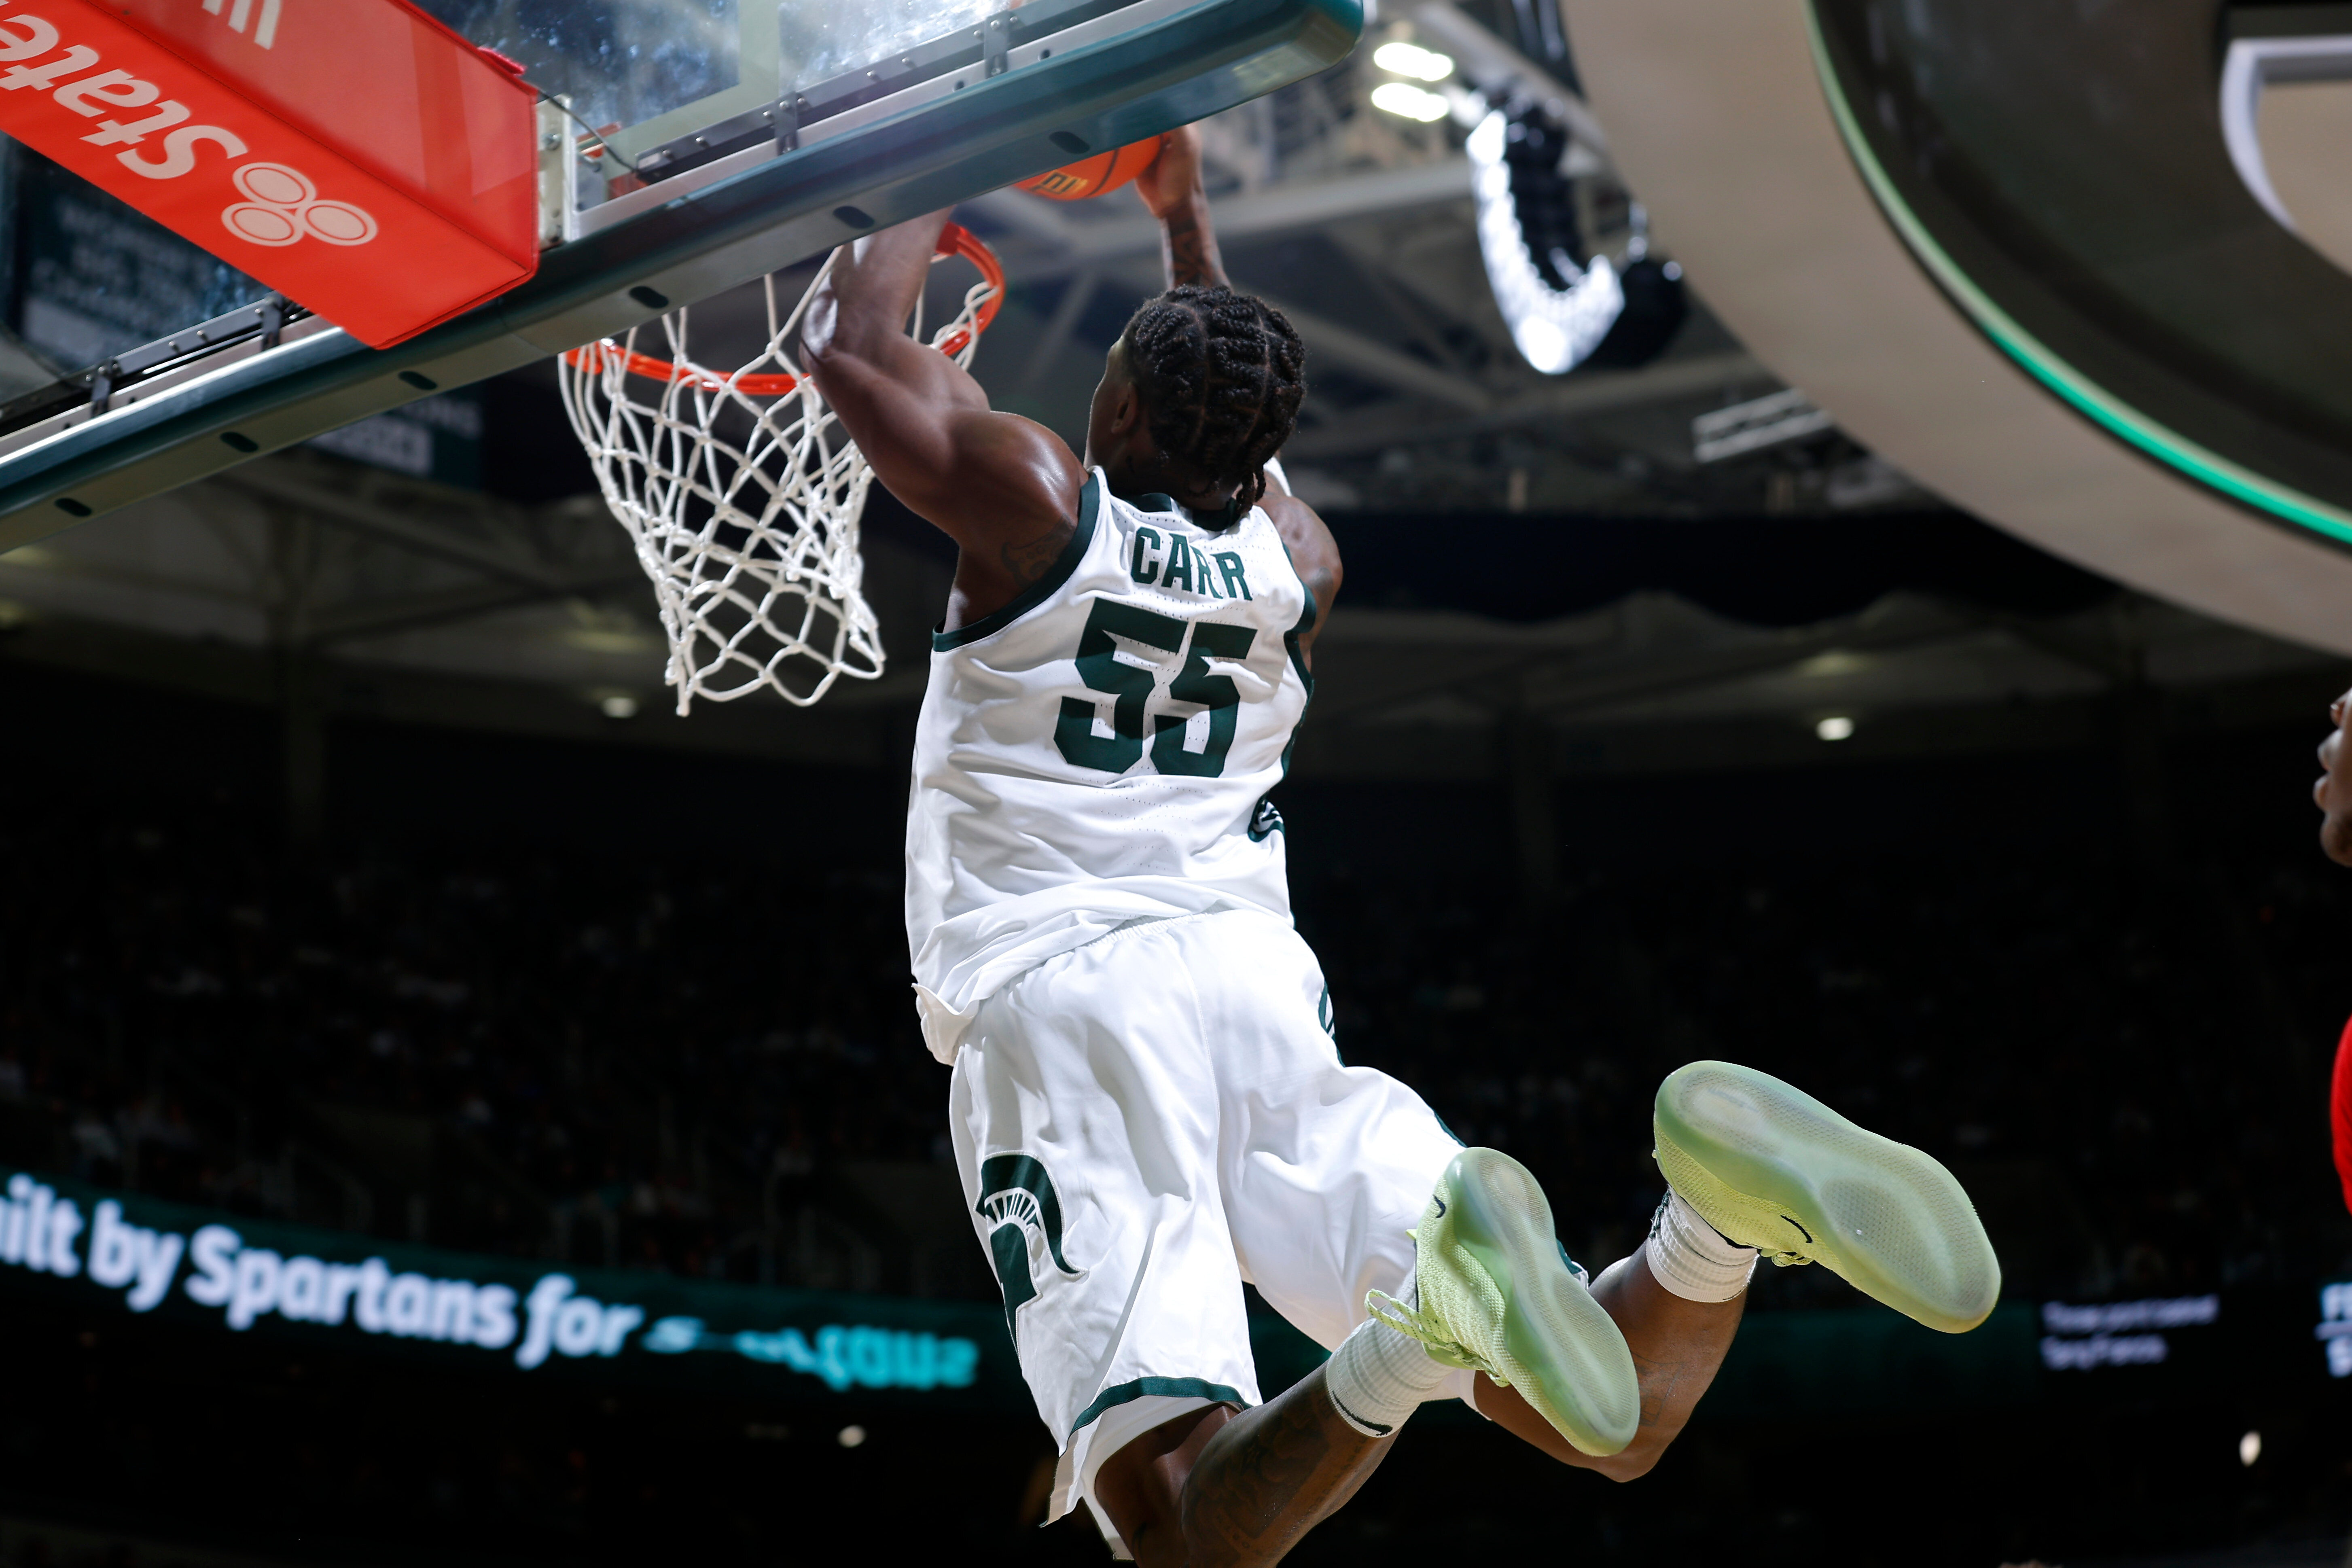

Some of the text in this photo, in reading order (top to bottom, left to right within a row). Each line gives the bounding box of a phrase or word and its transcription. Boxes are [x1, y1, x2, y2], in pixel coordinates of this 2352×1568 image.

[1131, 527, 1253, 601] CARR
[1053, 597, 1258, 778] 55
[0, 1174, 83, 1278] ilt
[87, 1199, 184, 1312] by
[185, 1224, 517, 1350] Spartans
[515, 1273, 644, 1370] for
